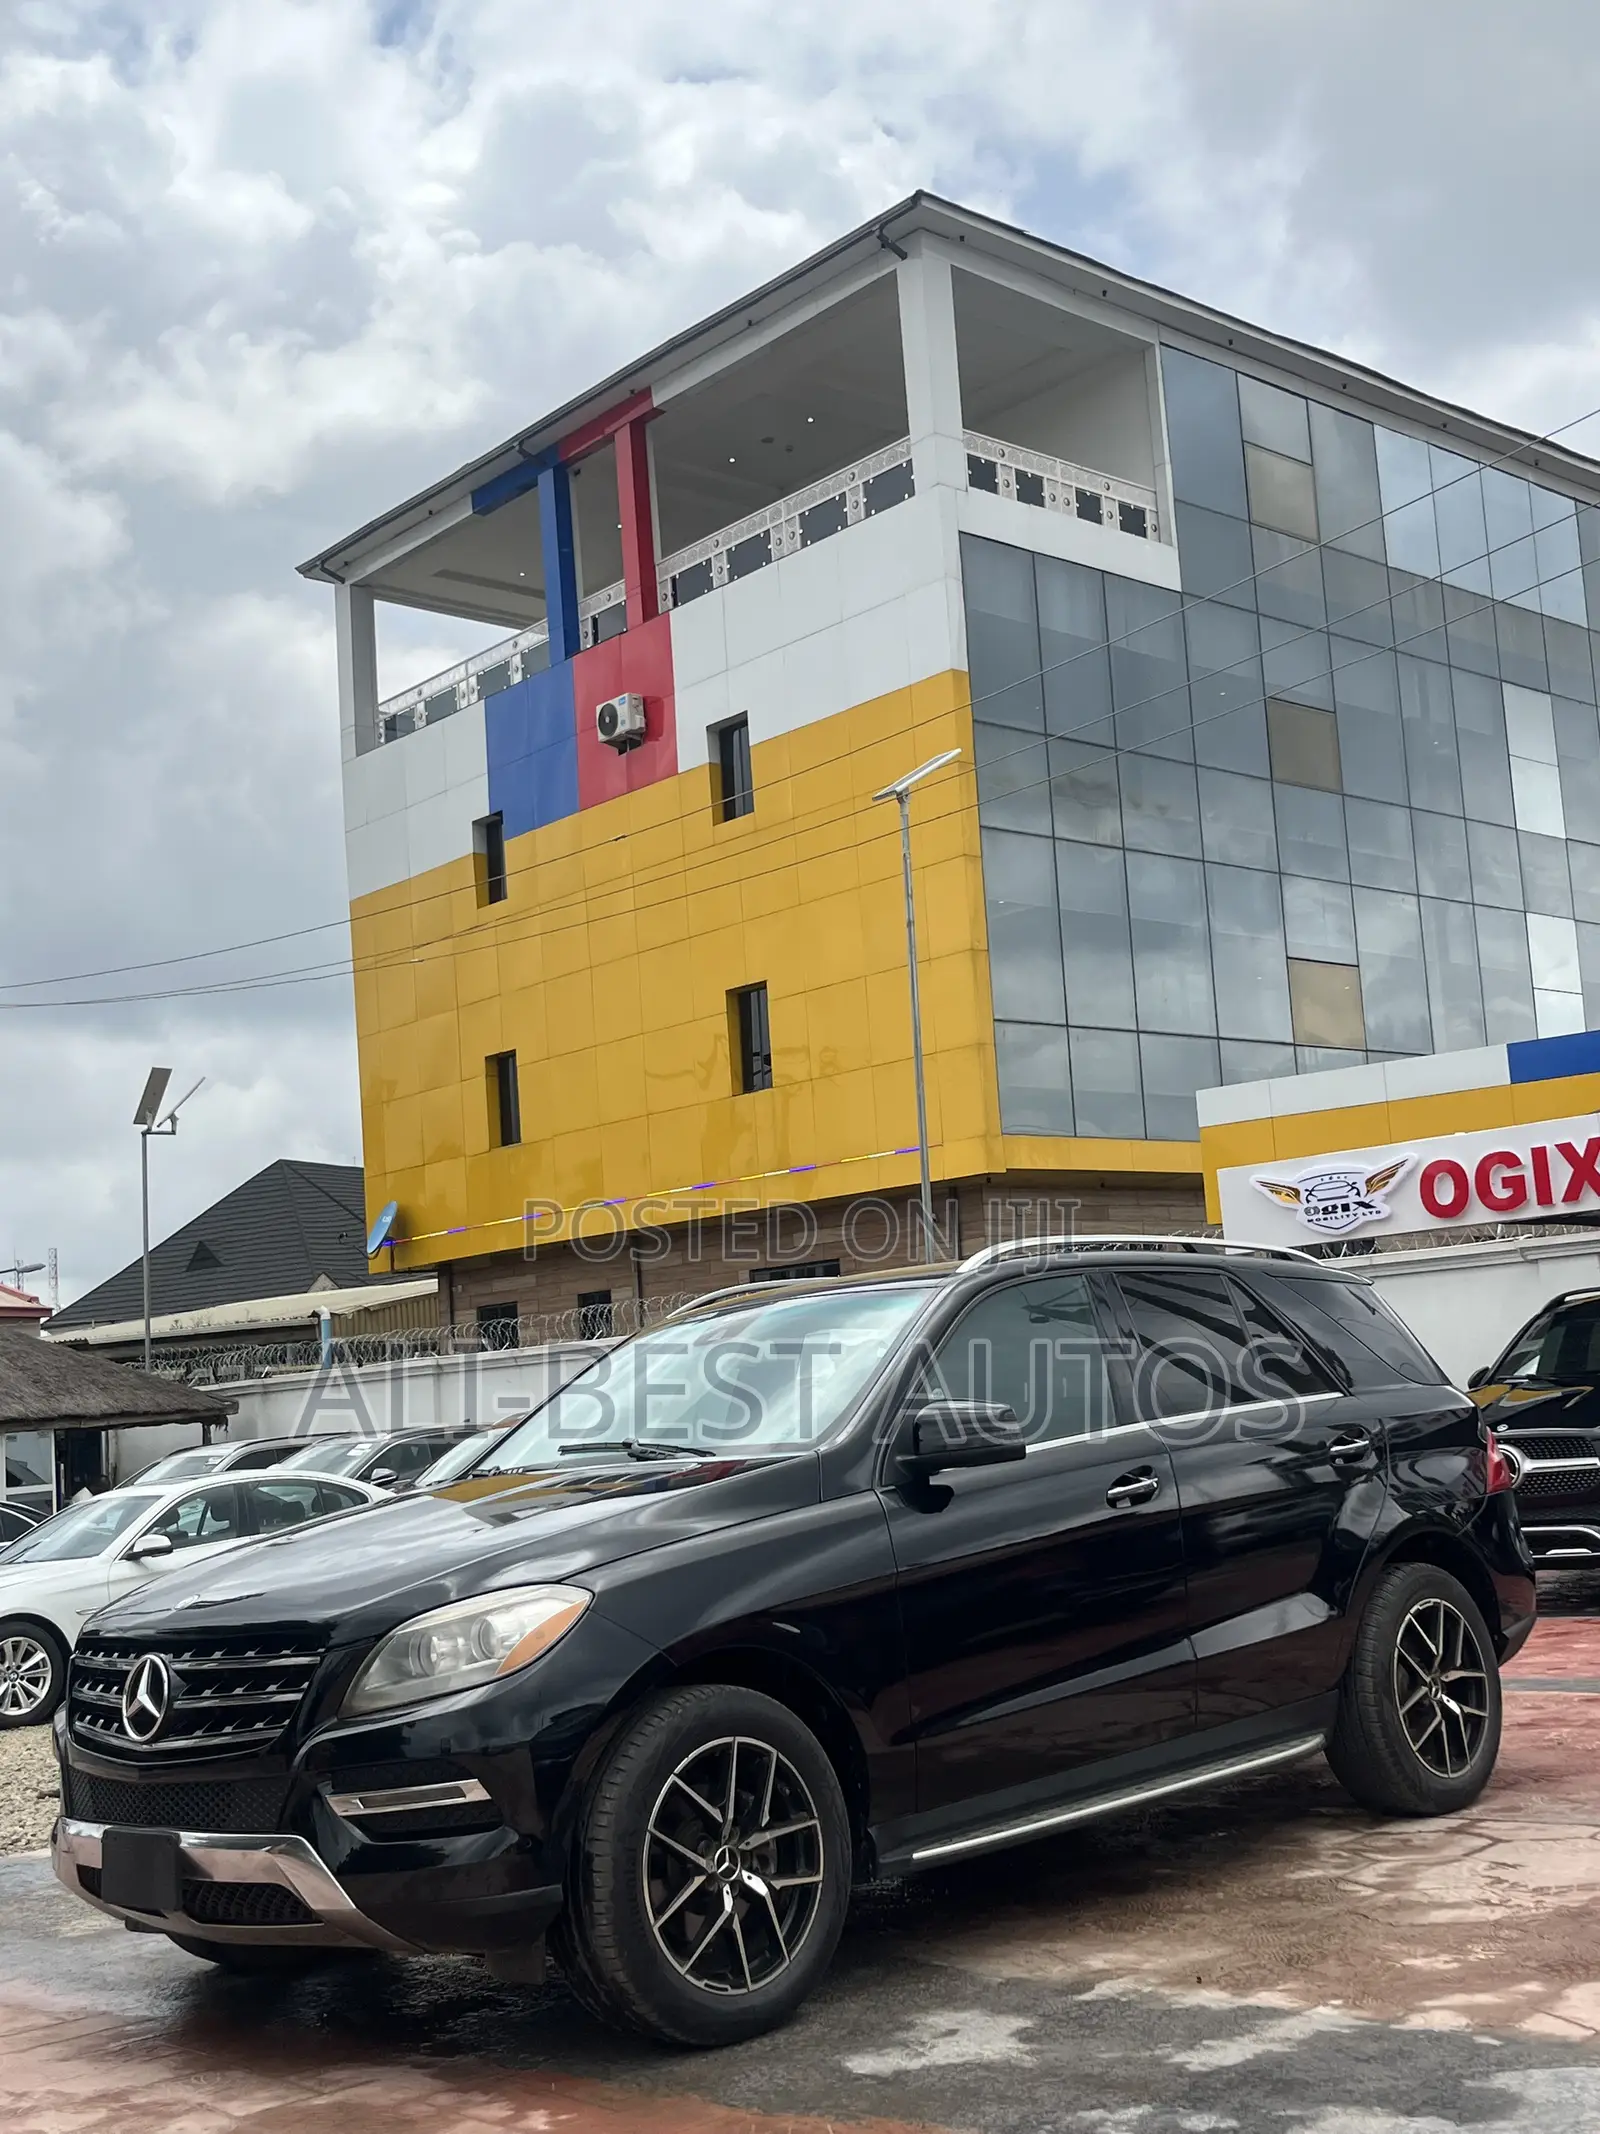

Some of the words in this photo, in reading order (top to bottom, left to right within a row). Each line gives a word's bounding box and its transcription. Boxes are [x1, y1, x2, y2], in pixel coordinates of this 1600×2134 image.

[1420, 1137, 1600, 1219] OGIX
[1307, 1213, 1358, 1223] MOBILITY
[1361, 1209, 1382, 1217] LTD
